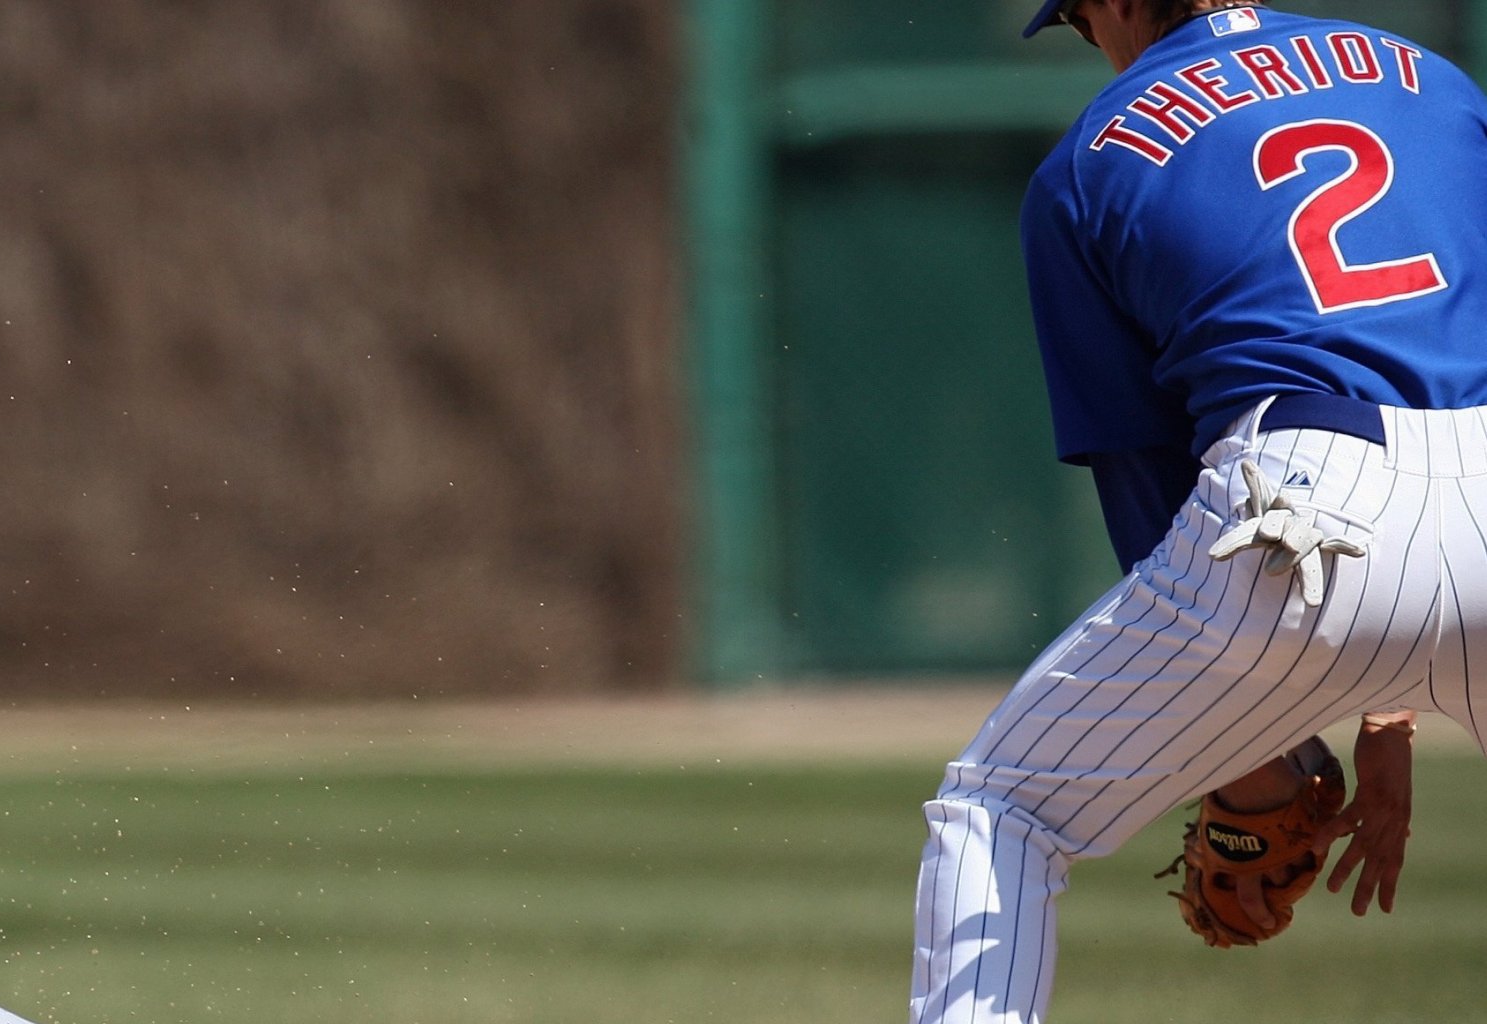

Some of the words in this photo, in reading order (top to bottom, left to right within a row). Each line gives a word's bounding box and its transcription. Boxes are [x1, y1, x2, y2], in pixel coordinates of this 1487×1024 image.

[1089, 32, 1423, 168] THERIOT
[1252, 118, 1449, 315] 2
[1208, 826, 1263, 853] Wilson
